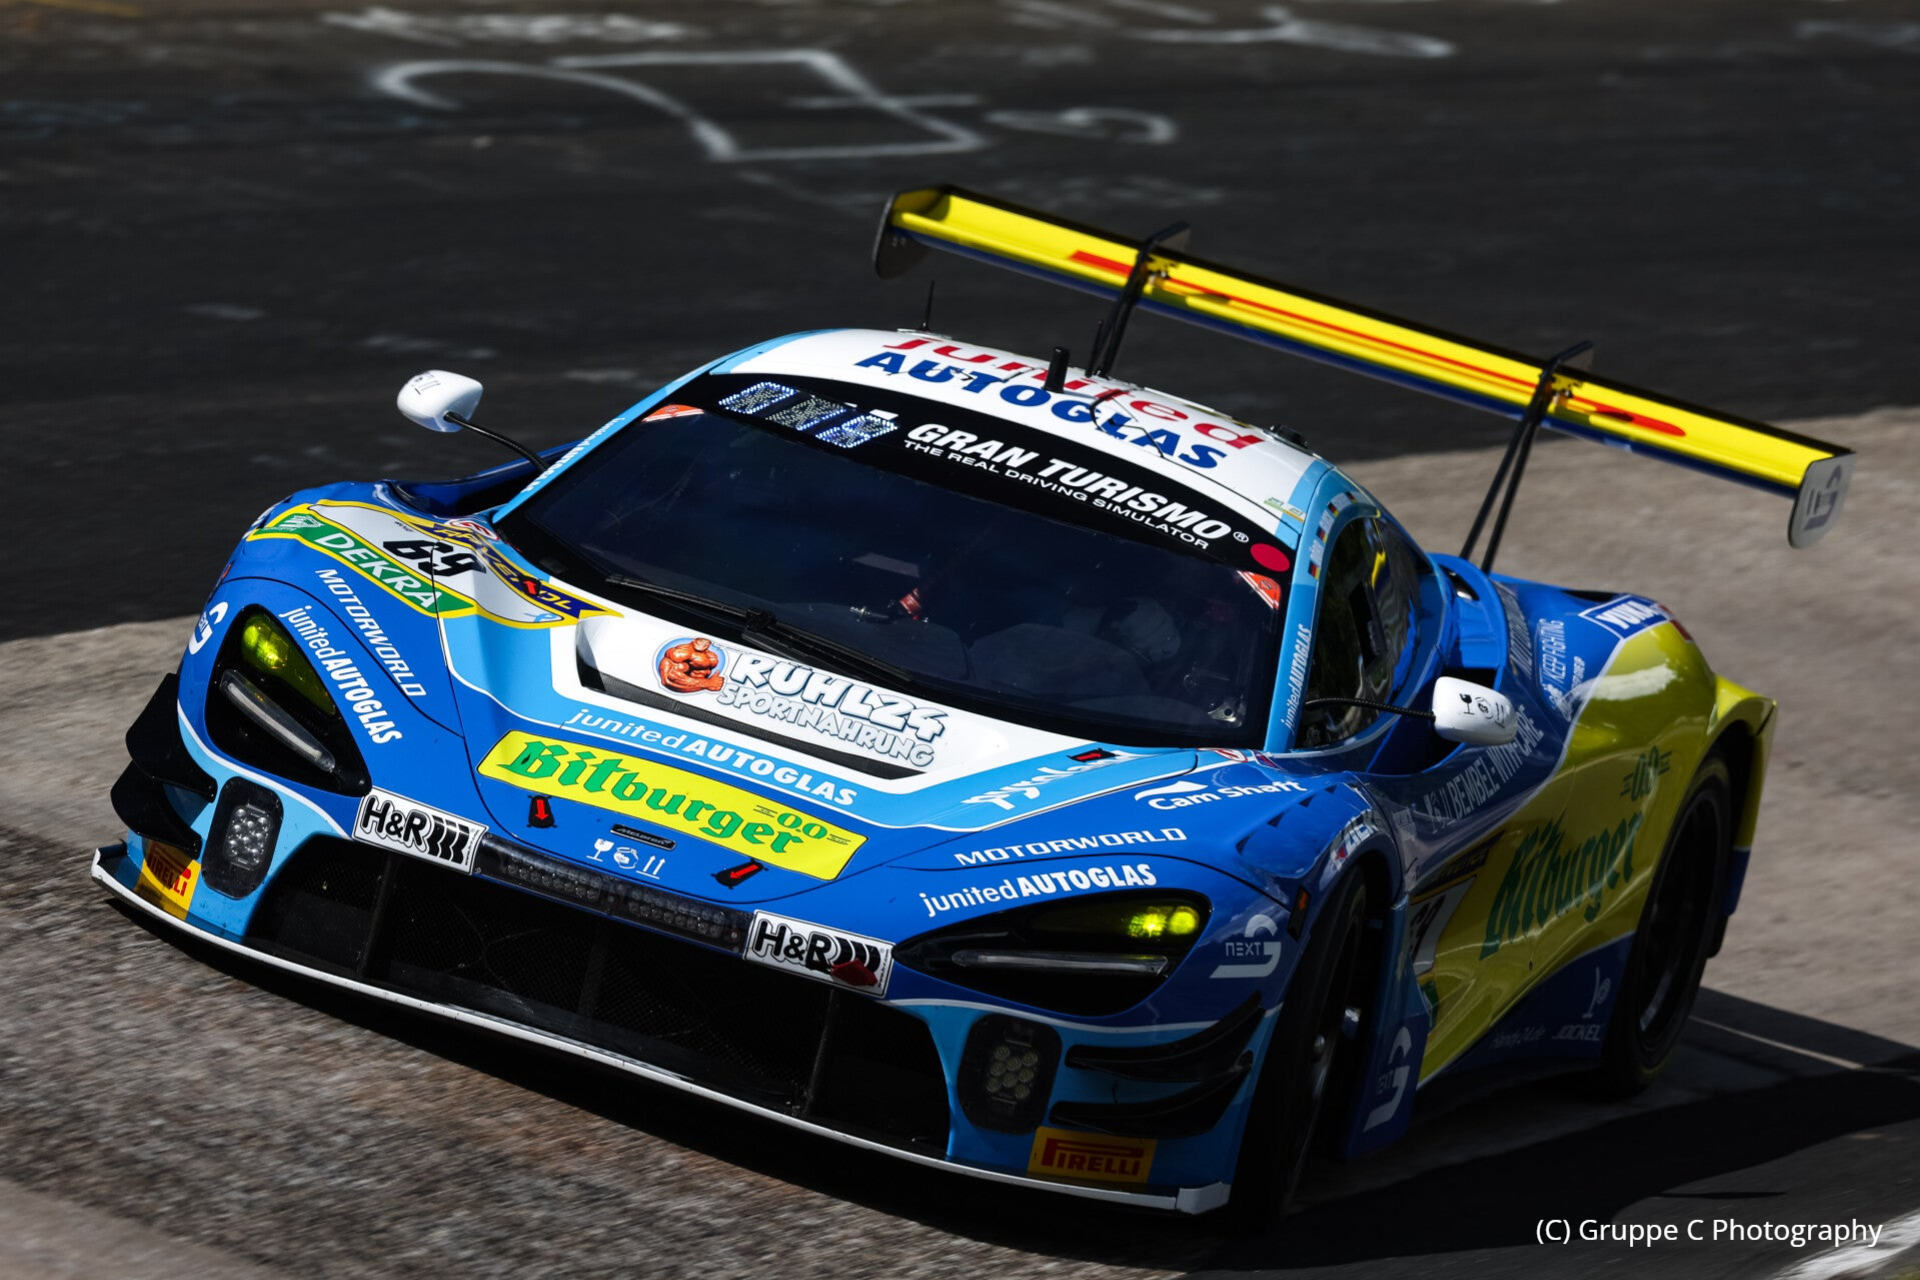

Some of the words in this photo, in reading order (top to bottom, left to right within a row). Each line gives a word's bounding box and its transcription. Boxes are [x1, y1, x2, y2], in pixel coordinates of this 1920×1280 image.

[854, 351, 1228, 469] AUTOGLAS
[902, 440, 942, 457] THE
[947, 450, 1000, 476] REAL
[1004, 466, 1090, 501] DRIVING
[1091, 495, 1210, 551] SIMULATOR
[906, 422, 1039, 470] GRAN
[1037, 459, 1232, 541] TURISMO
[315, 532, 445, 610] DEKRA
[383, 538, 487, 577] 69
[433, 522, 572, 610] RAVEOL
[315, 568, 427, 697] MOTORWORLD
[716, 684, 935, 768] SPORTNAHRUNG
[729, 651, 949, 743] RÜHL24
[361, 797, 430, 852] H&R
[497, 740, 806, 855] Bitburger
[777, 812, 828, 840] 0.0
[1148, 792, 1222, 811] Cam
[1217, 780, 1307, 800] Shaft
[954, 827, 1188, 866] MOTORWORLD
[1479, 810, 1643, 961] Bitburger
[753, 920, 836, 973] H&R
[1041, 1137, 1146, 1177] PIRELLI
